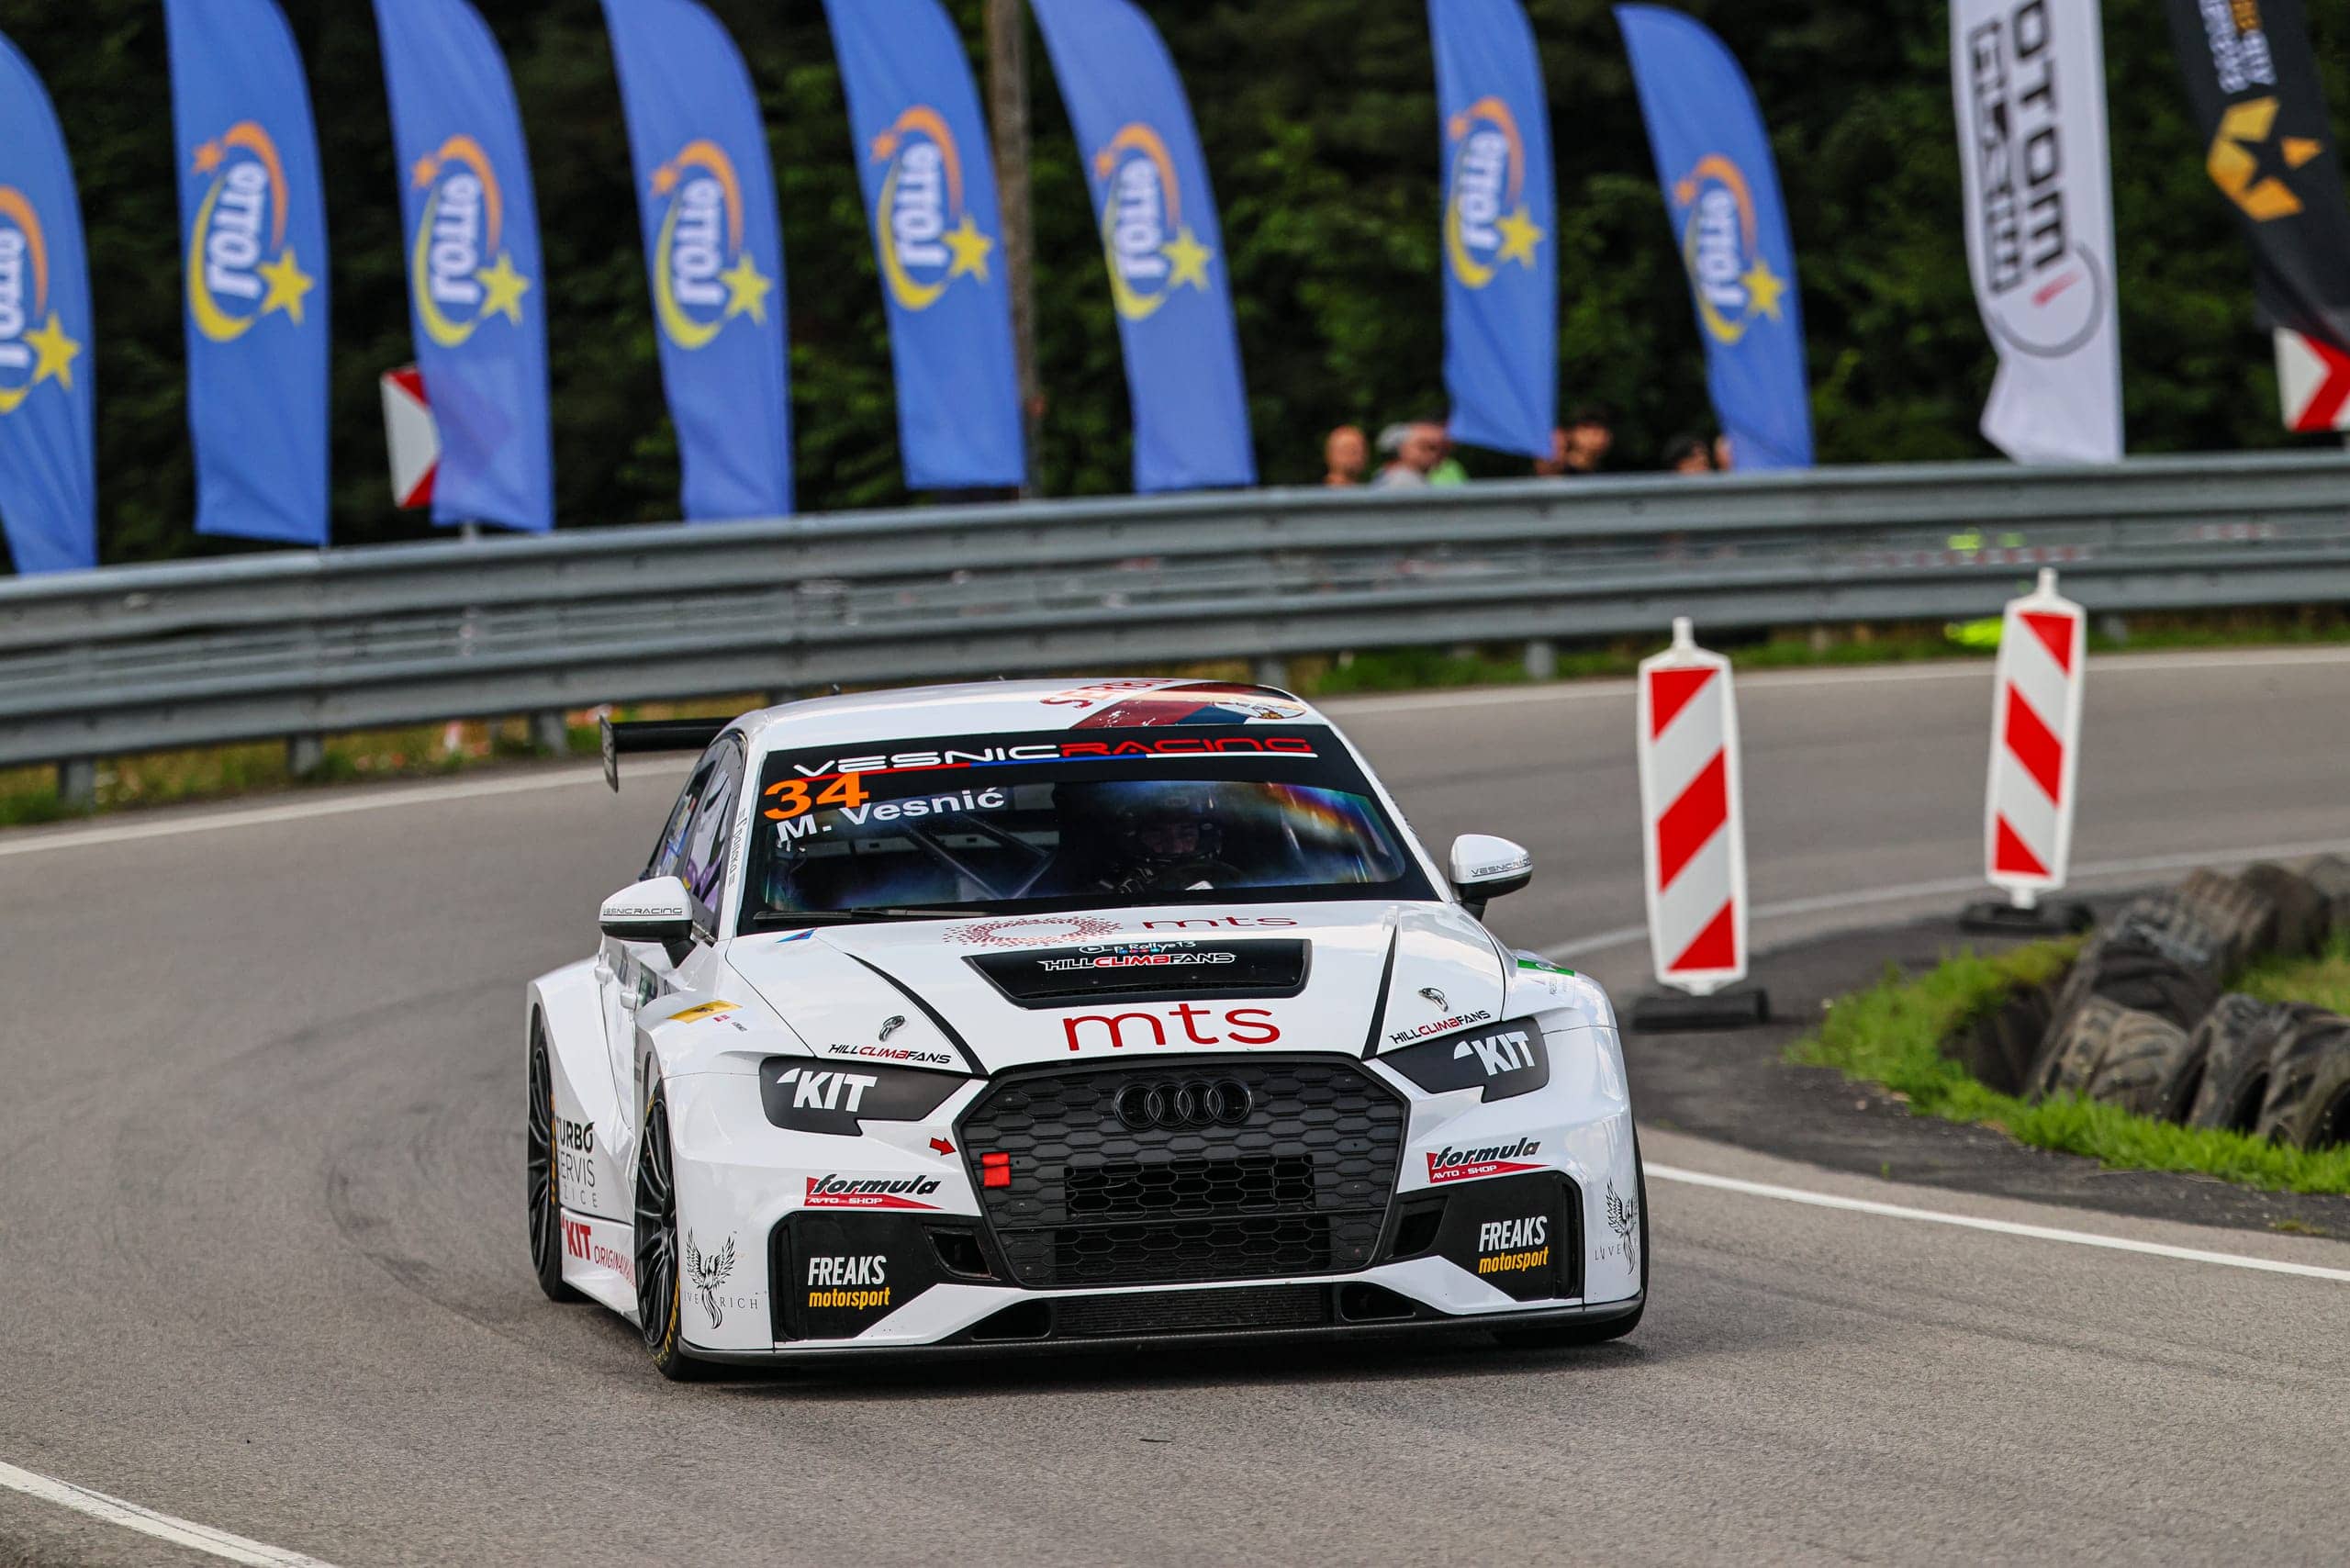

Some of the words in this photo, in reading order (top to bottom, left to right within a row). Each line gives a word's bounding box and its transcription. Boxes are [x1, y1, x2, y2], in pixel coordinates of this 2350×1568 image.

[764, 771, 869, 820] 34
[776, 813, 832, 843] M.
[839, 787, 1004, 825] Vesnić
[1142, 916, 1297, 929] mts
[1062, 1003, 1281, 1051] mts
[1432, 1137, 1541, 1169] formula
[558, 1149, 596, 1188] ERVIS
[1433, 1170, 1460, 1180] AVTO
[1468, 1165, 1498, 1174] SHOP
[564, 1184, 599, 1208] ZICE
[813, 1173, 942, 1195] formula
[1478, 1215, 1548, 1252] FREAKS
[808, 1255, 887, 1286] FREAKS
[1478, 1246, 1550, 1274] motorsport
[720, 1296, 758, 1309] RICH
[809, 1286, 890, 1310] motorsport
